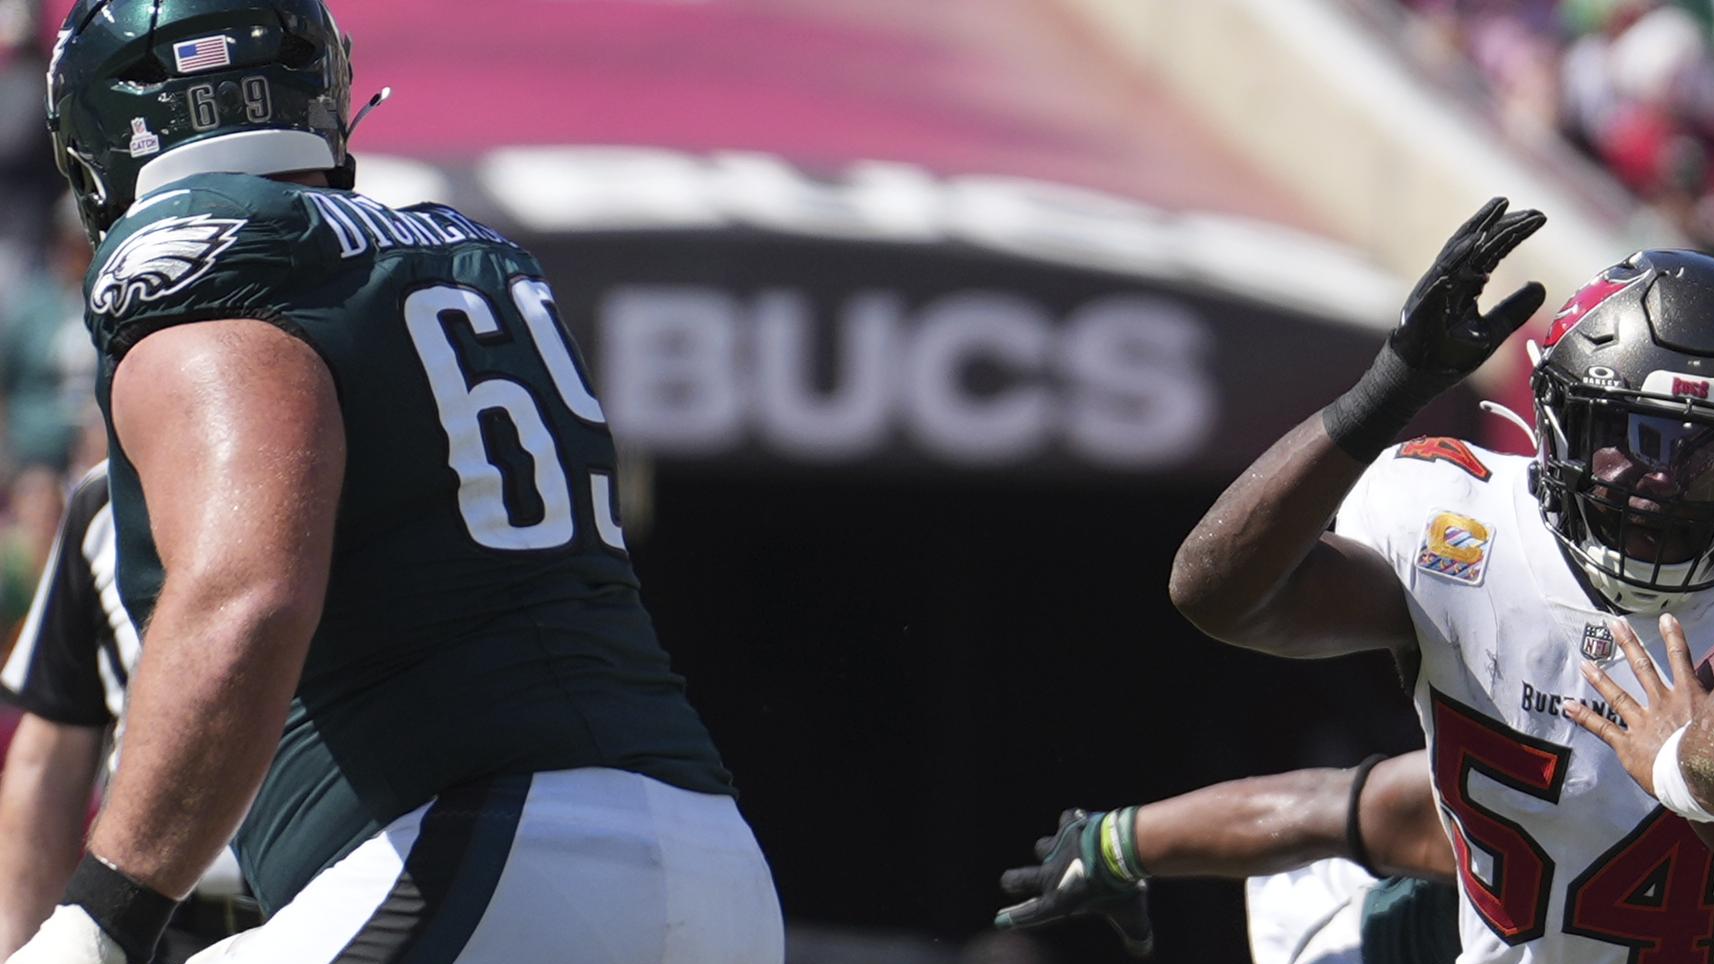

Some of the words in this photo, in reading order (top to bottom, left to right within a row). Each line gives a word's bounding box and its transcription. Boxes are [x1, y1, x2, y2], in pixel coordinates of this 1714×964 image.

[187, 76, 272, 131] 69
[603, 286, 1216, 466] BUCS
[1583, 637, 1611, 658] NFL
